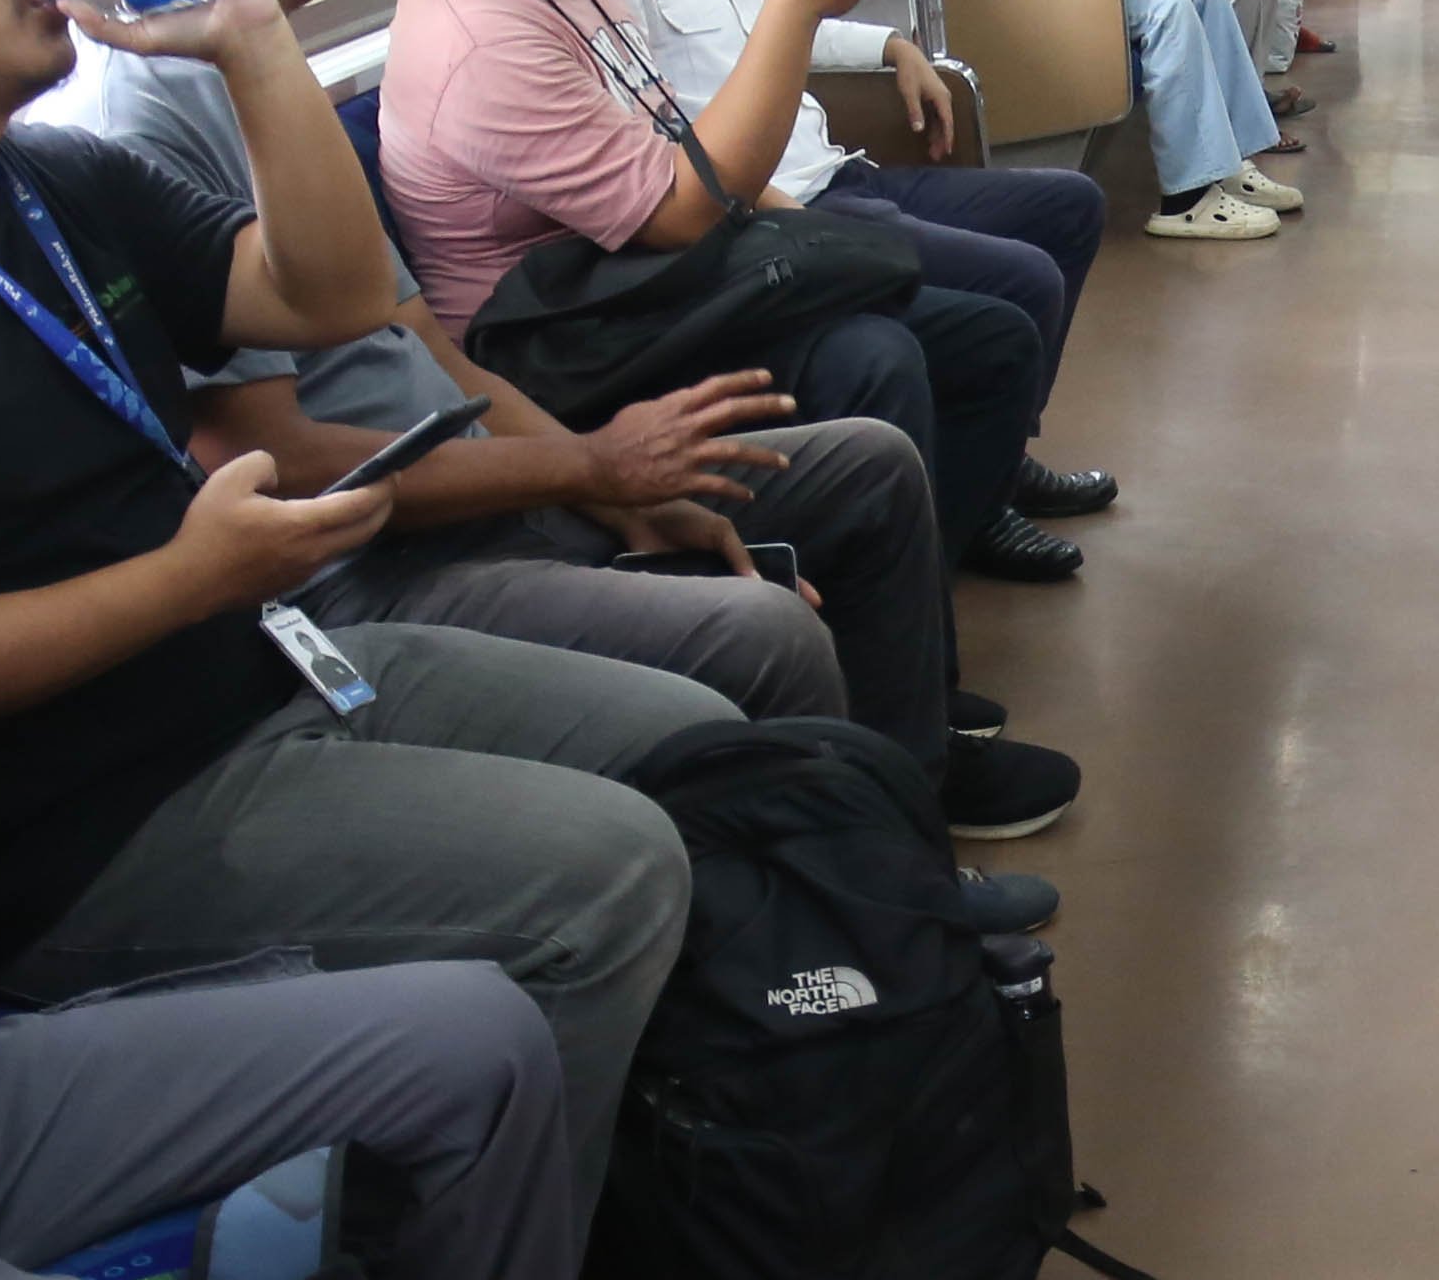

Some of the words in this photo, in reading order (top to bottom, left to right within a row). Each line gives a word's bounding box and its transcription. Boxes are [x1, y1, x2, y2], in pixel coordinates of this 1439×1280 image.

[792, 967, 834, 988] THE
[767, 983, 837, 1006] NORTH
[788, 998, 840, 1016] FACE
